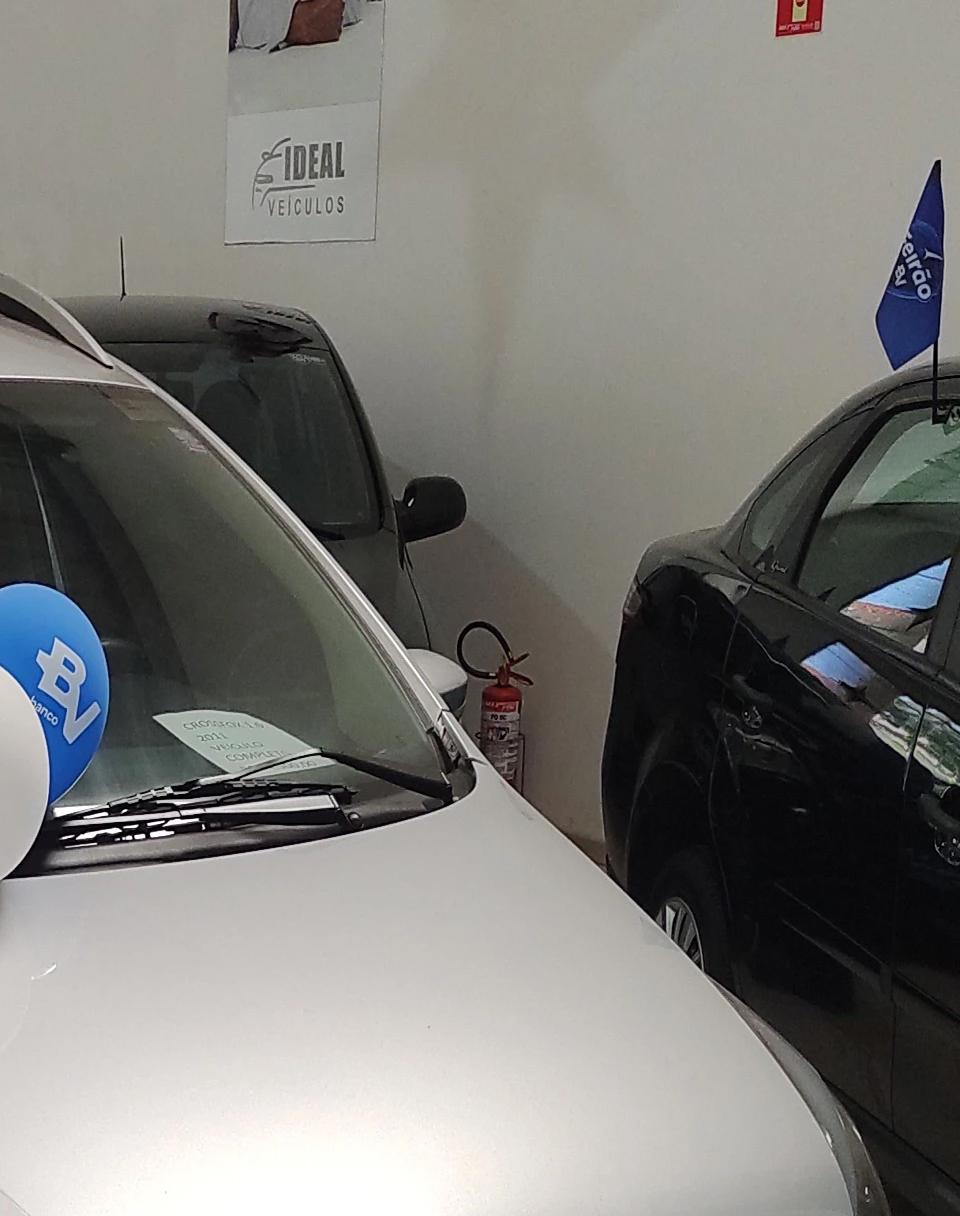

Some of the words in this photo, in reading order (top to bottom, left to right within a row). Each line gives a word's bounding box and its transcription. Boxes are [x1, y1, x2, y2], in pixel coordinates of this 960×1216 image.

[284, 141, 345, 181] IDEAL
[268, 195, 344, 217] VEÍCULOS
[901, 231, 932, 300] eirão
[35, 637, 102, 745] BV
[31, 695, 59, 726] banco
[225, 750, 292, 762] COMPLET
